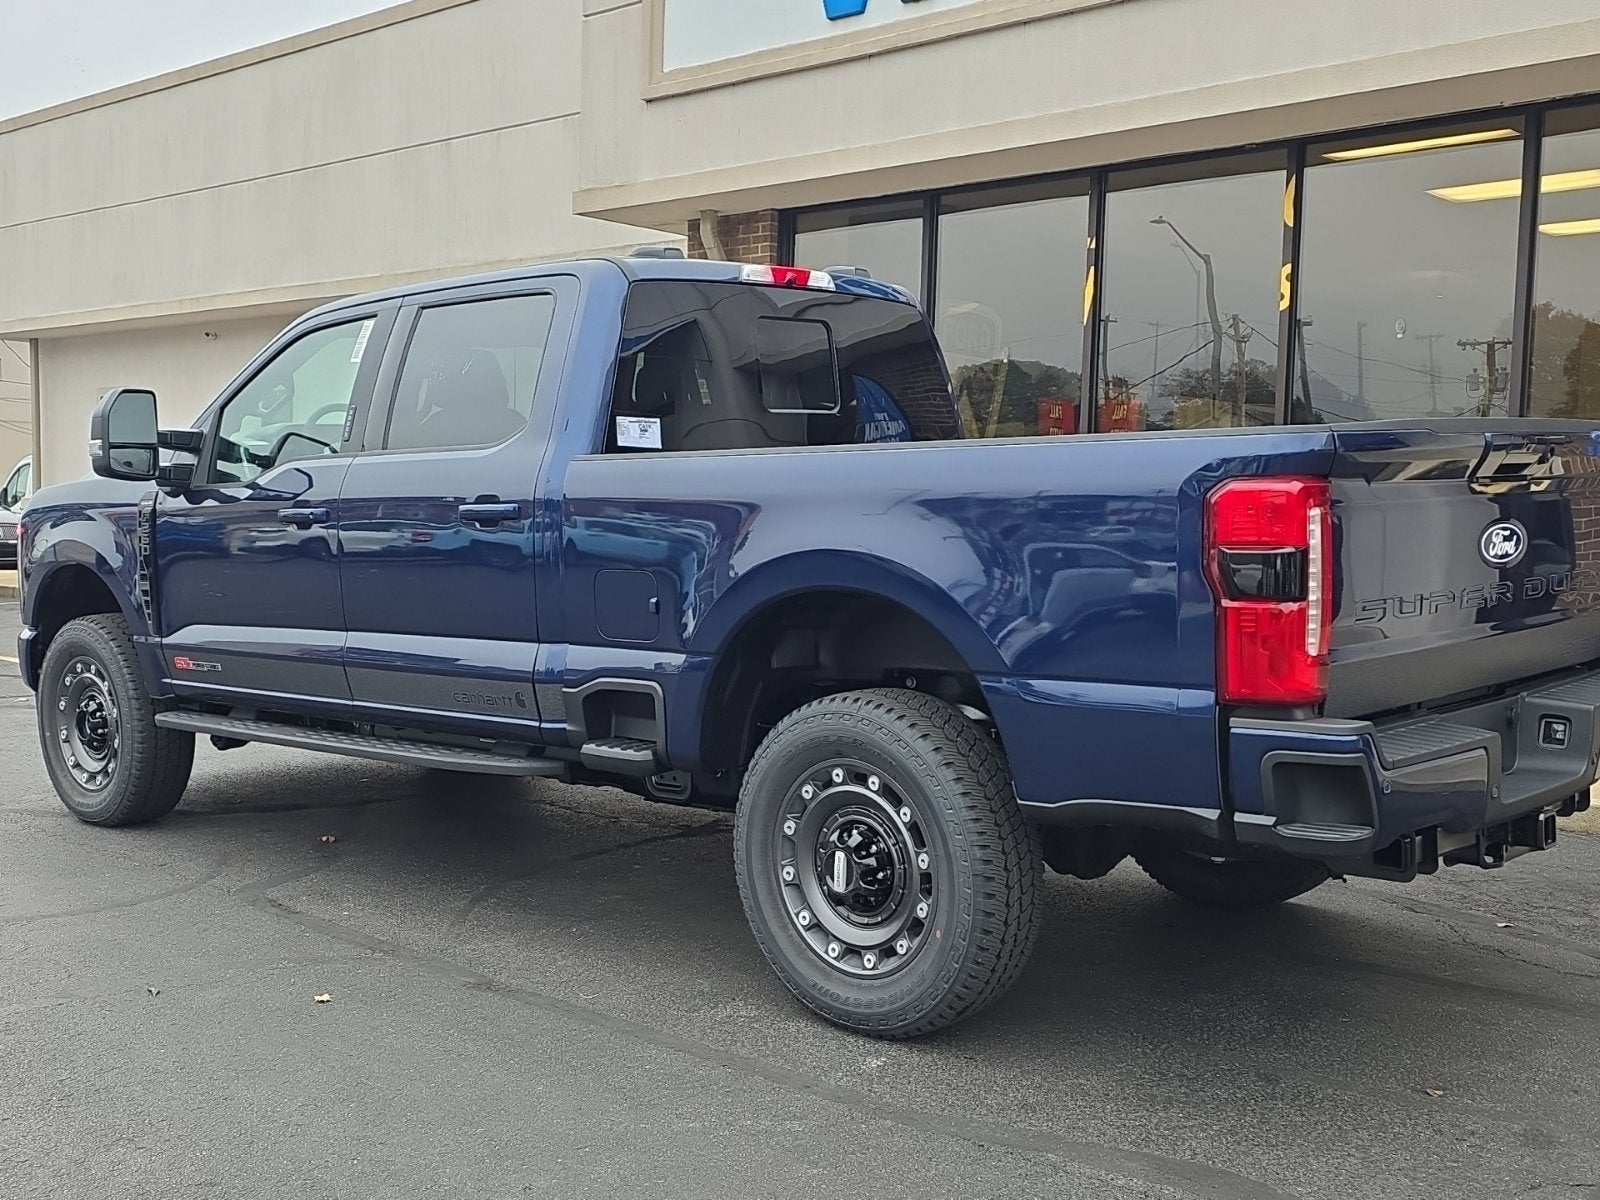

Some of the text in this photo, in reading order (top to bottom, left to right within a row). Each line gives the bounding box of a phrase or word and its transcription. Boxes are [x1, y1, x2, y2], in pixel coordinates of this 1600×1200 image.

[1489, 529, 1516, 556] Ford
[1353, 581, 1514, 625] SUPER
[453, 691, 514, 708] carhartt
